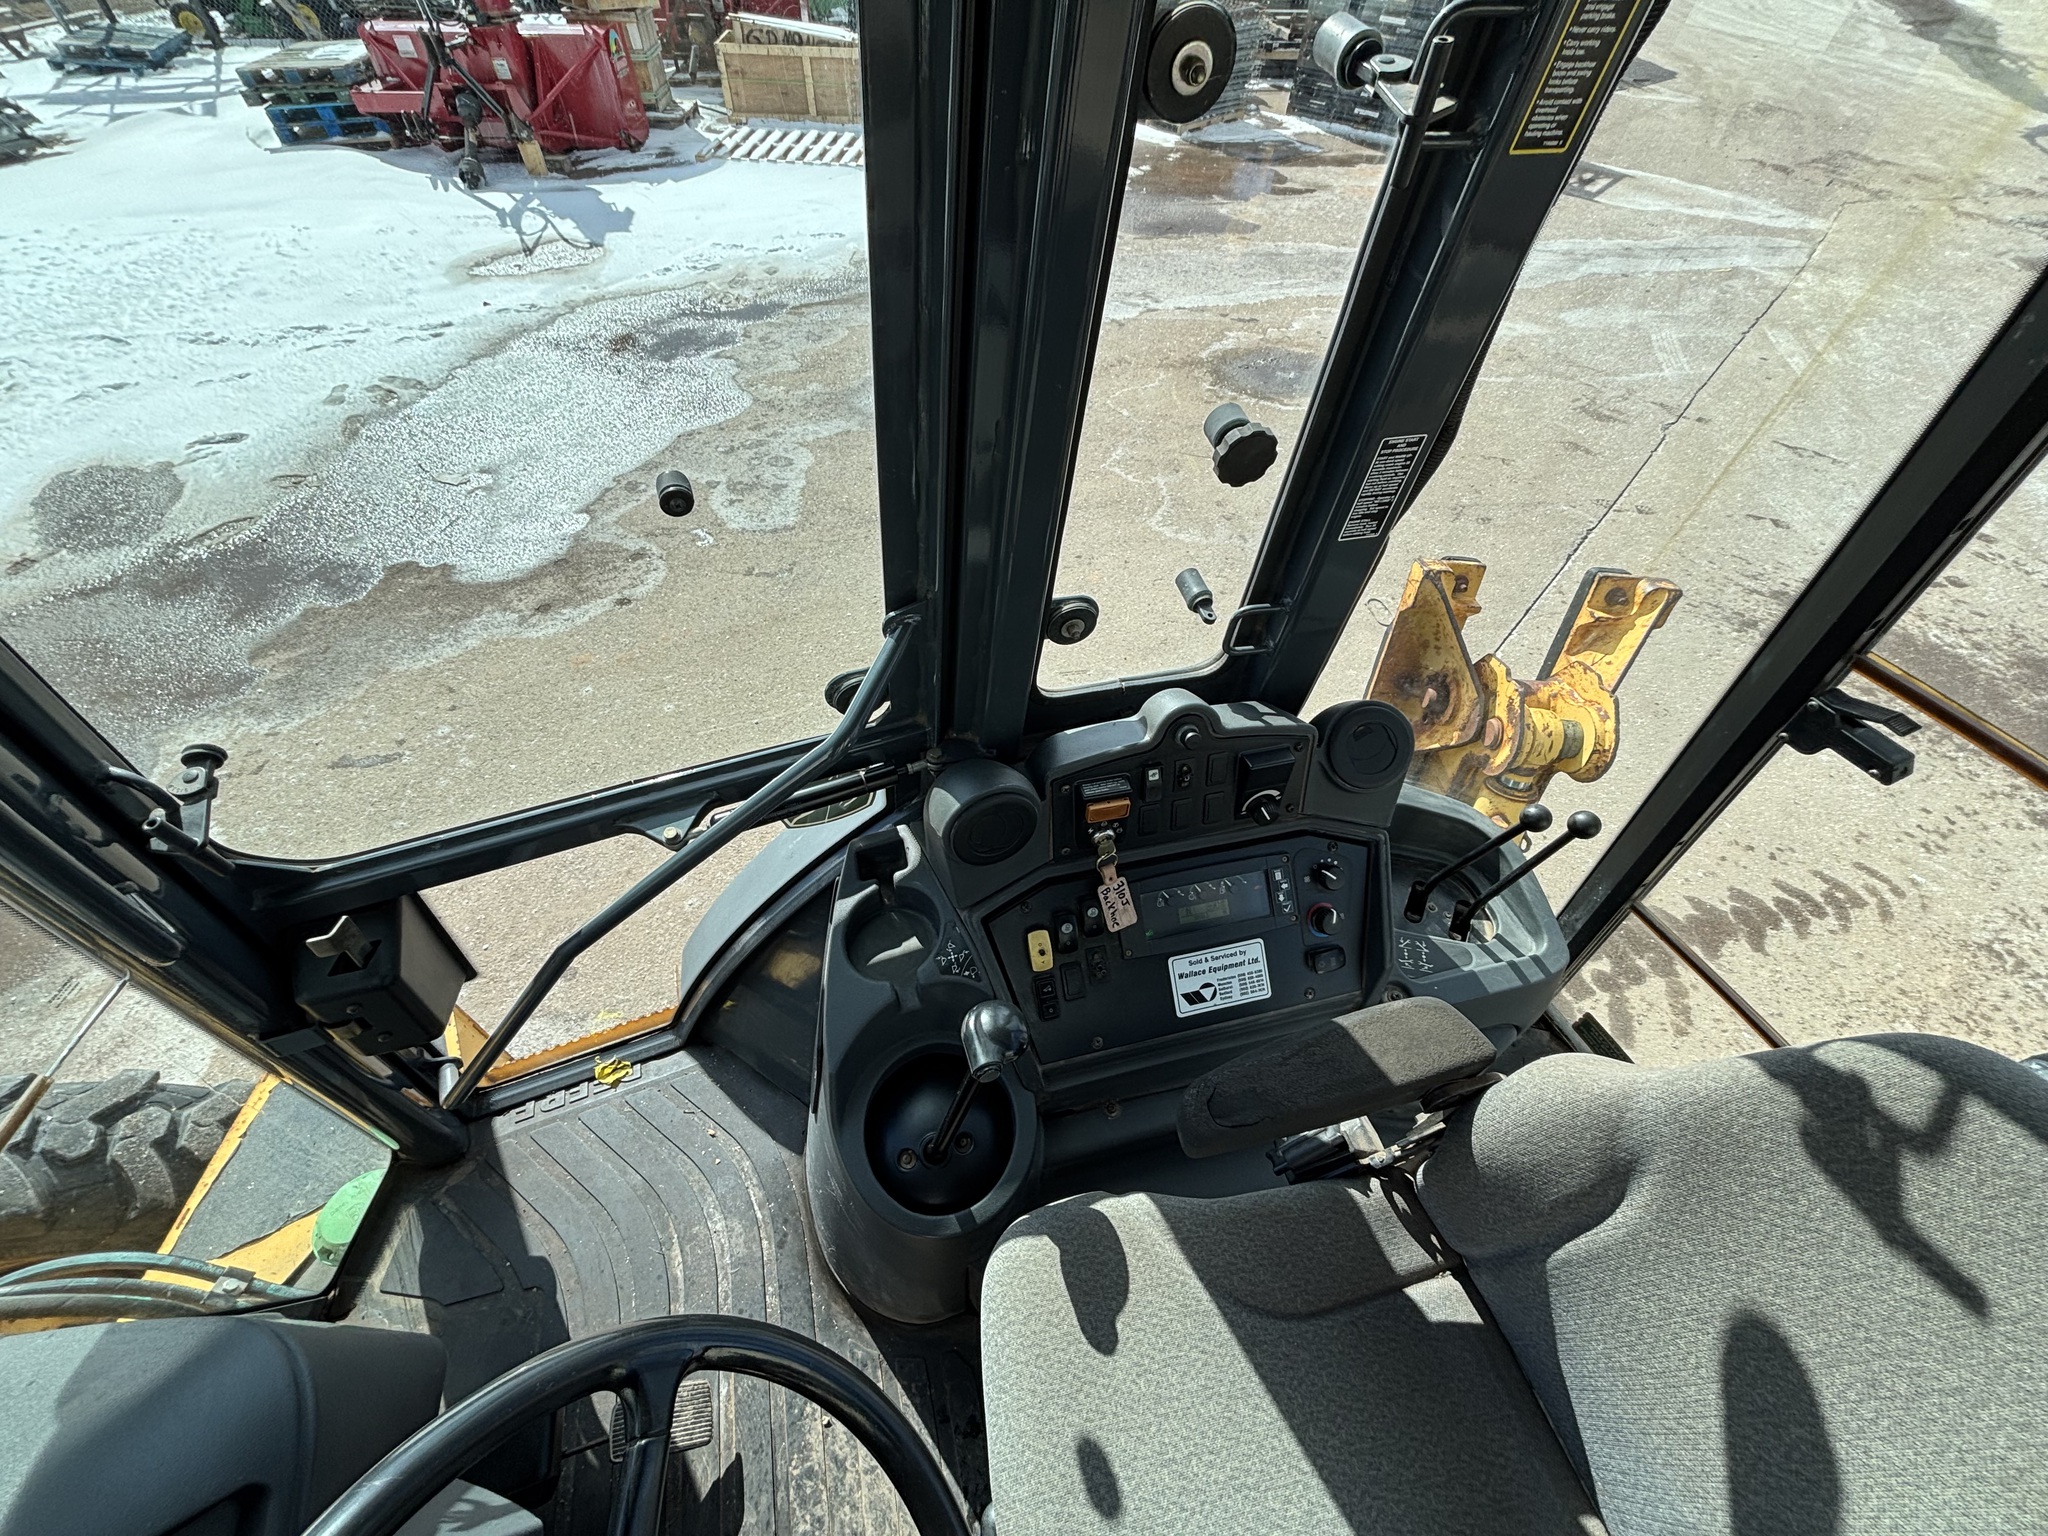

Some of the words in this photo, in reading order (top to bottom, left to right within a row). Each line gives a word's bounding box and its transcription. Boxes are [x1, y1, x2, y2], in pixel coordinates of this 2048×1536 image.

[1113, 880, 1130, 906] 310J
[1177, 969, 1206, 980] Wallace
[1209, 959, 1246, 973] Equipment
[1248, 957, 1261, 965] Ltd.
[1188, 958, 1203, 966] Sold
[1211, 951, 1237, 962] Serviced
